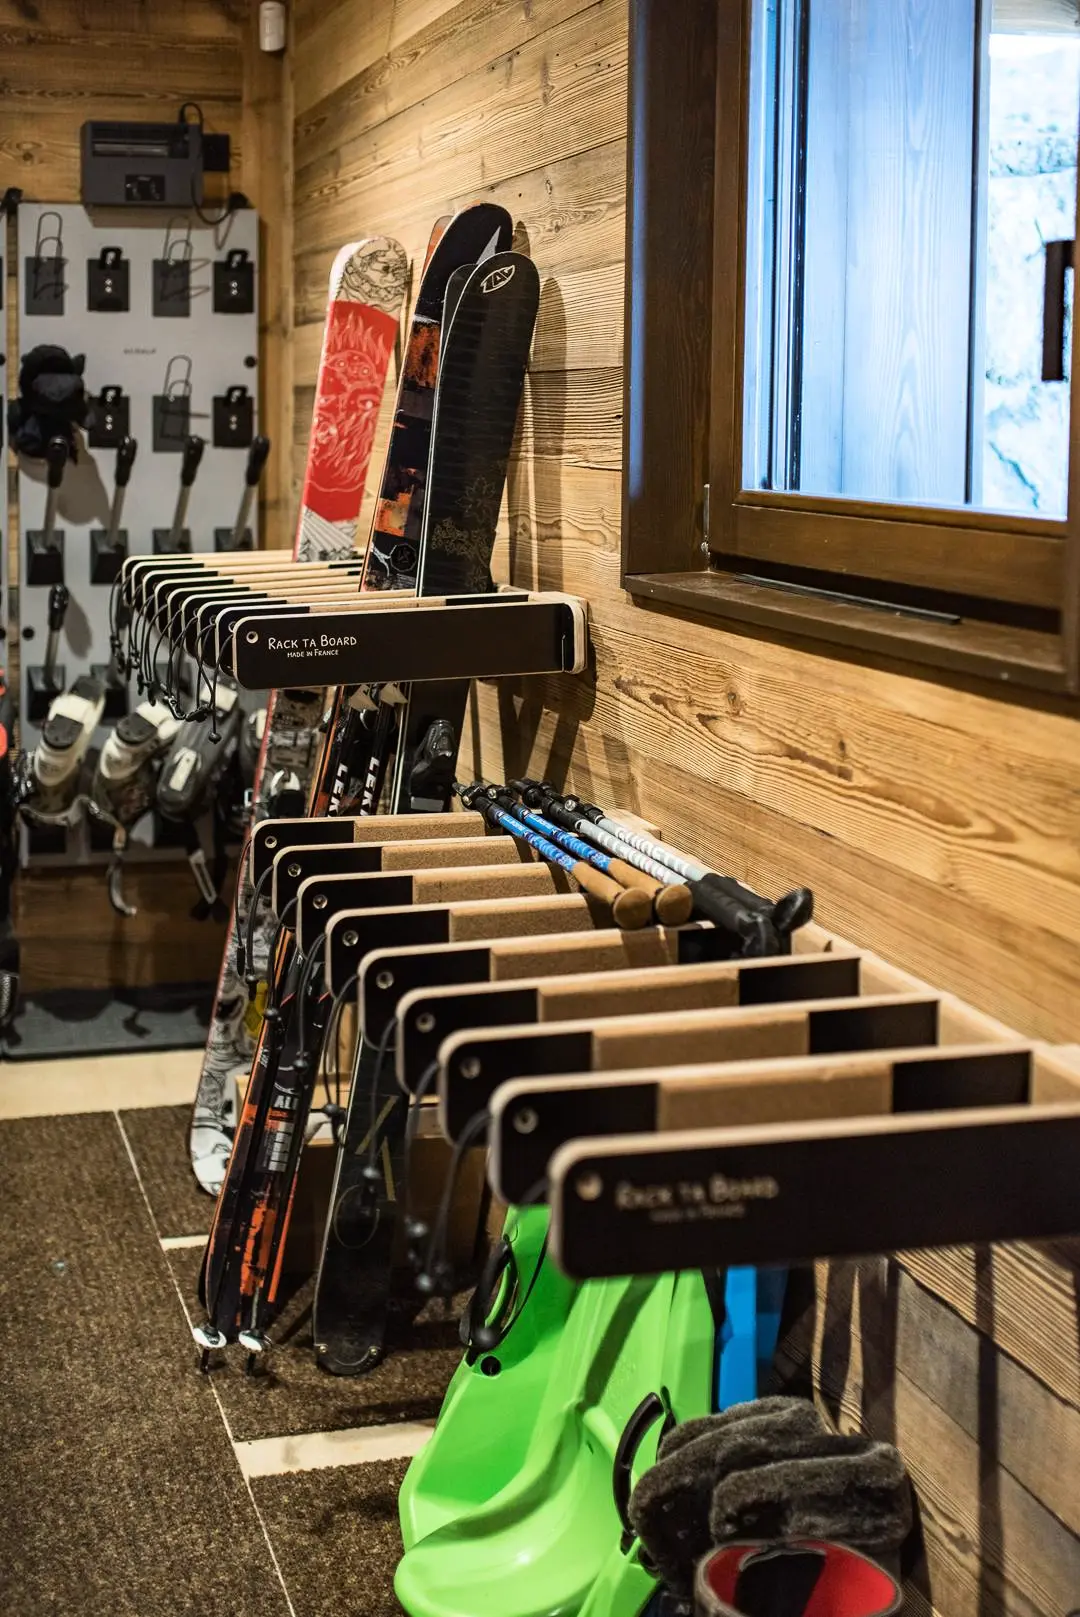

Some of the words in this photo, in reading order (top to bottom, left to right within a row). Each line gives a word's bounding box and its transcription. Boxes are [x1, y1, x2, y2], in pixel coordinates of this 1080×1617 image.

[268, 637, 299, 650] RACK
[302, 638, 317, 648] TA
[320, 634, 357, 647] BOARD
[287, 650, 305, 658] MADE
[314, 648, 340, 657] FRANCE
[327, 762, 349, 818] LEK
